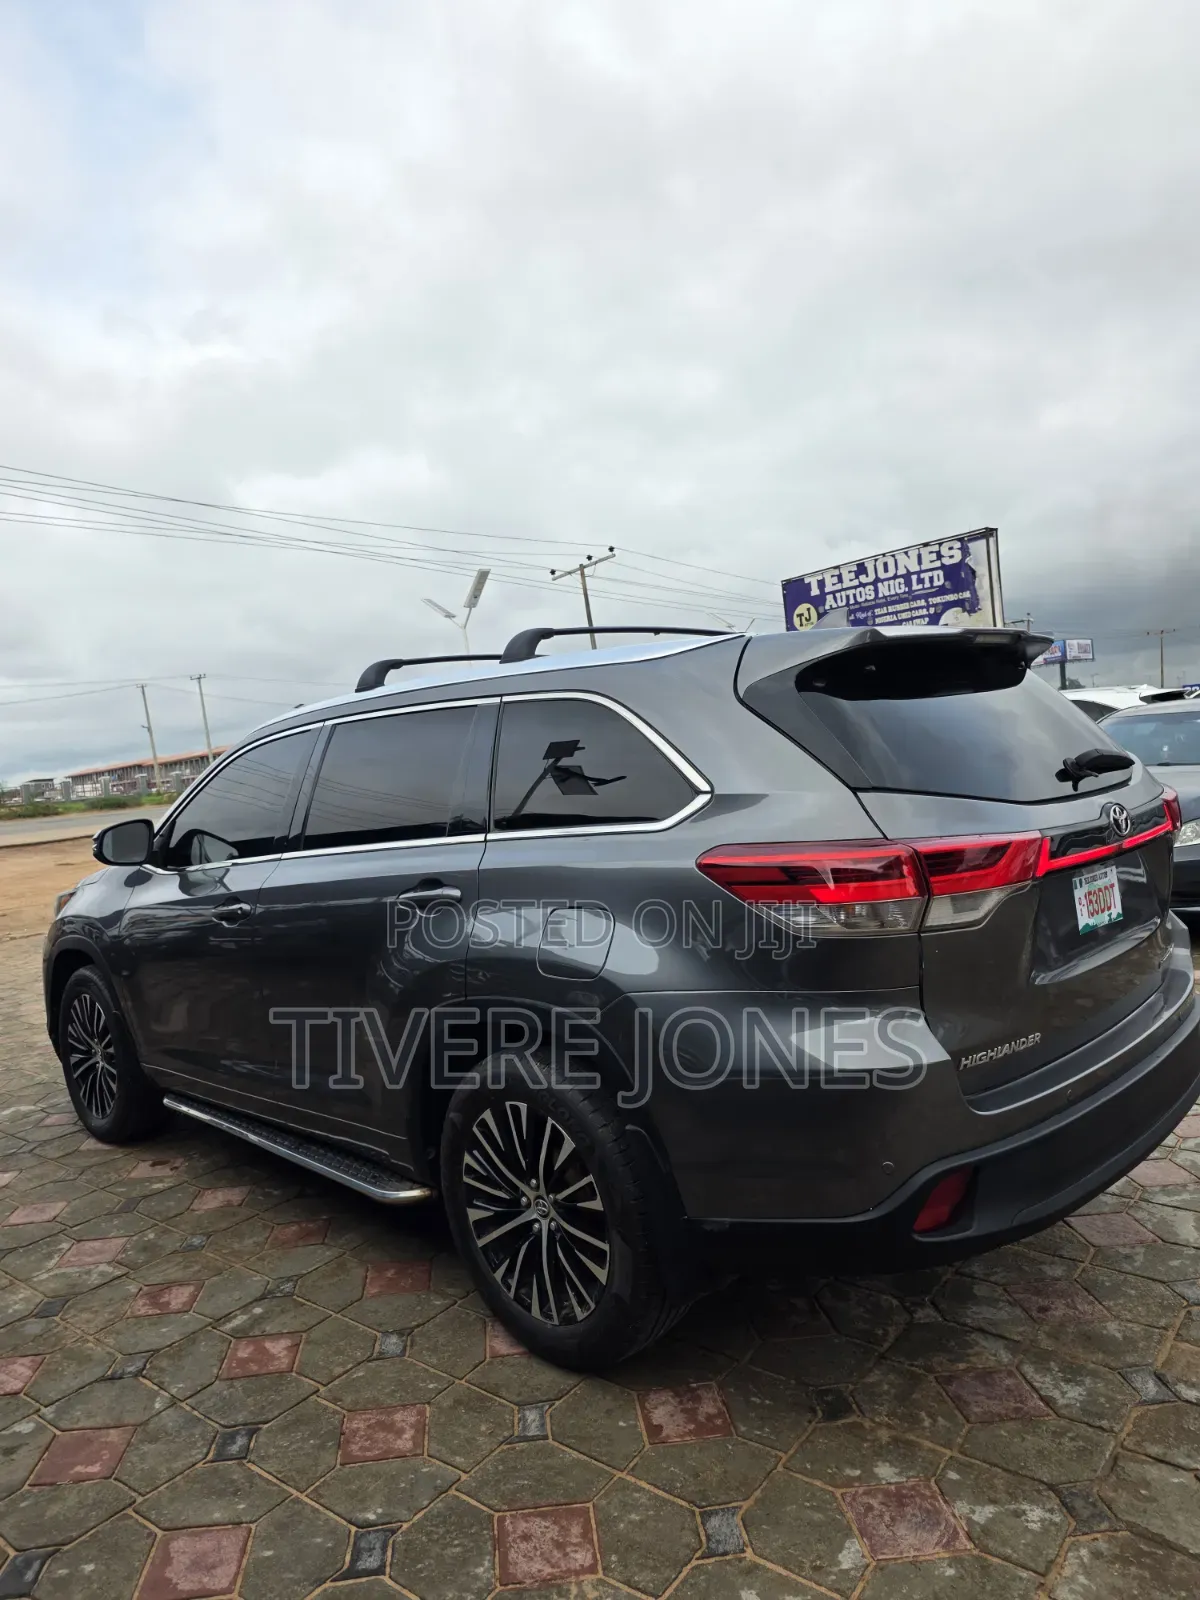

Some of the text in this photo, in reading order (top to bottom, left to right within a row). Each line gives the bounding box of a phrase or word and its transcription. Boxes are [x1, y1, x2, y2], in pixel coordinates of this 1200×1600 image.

[804, 541, 963, 596] TEEJONES
[824, 585, 875, 610] AUTOS
[878, 577, 909, 598] NIG.
[911, 569, 945, 590] LTD
[796, 607, 812, 627] TJ
[959, 1032, 1042, 1070] HIGHLANDER
